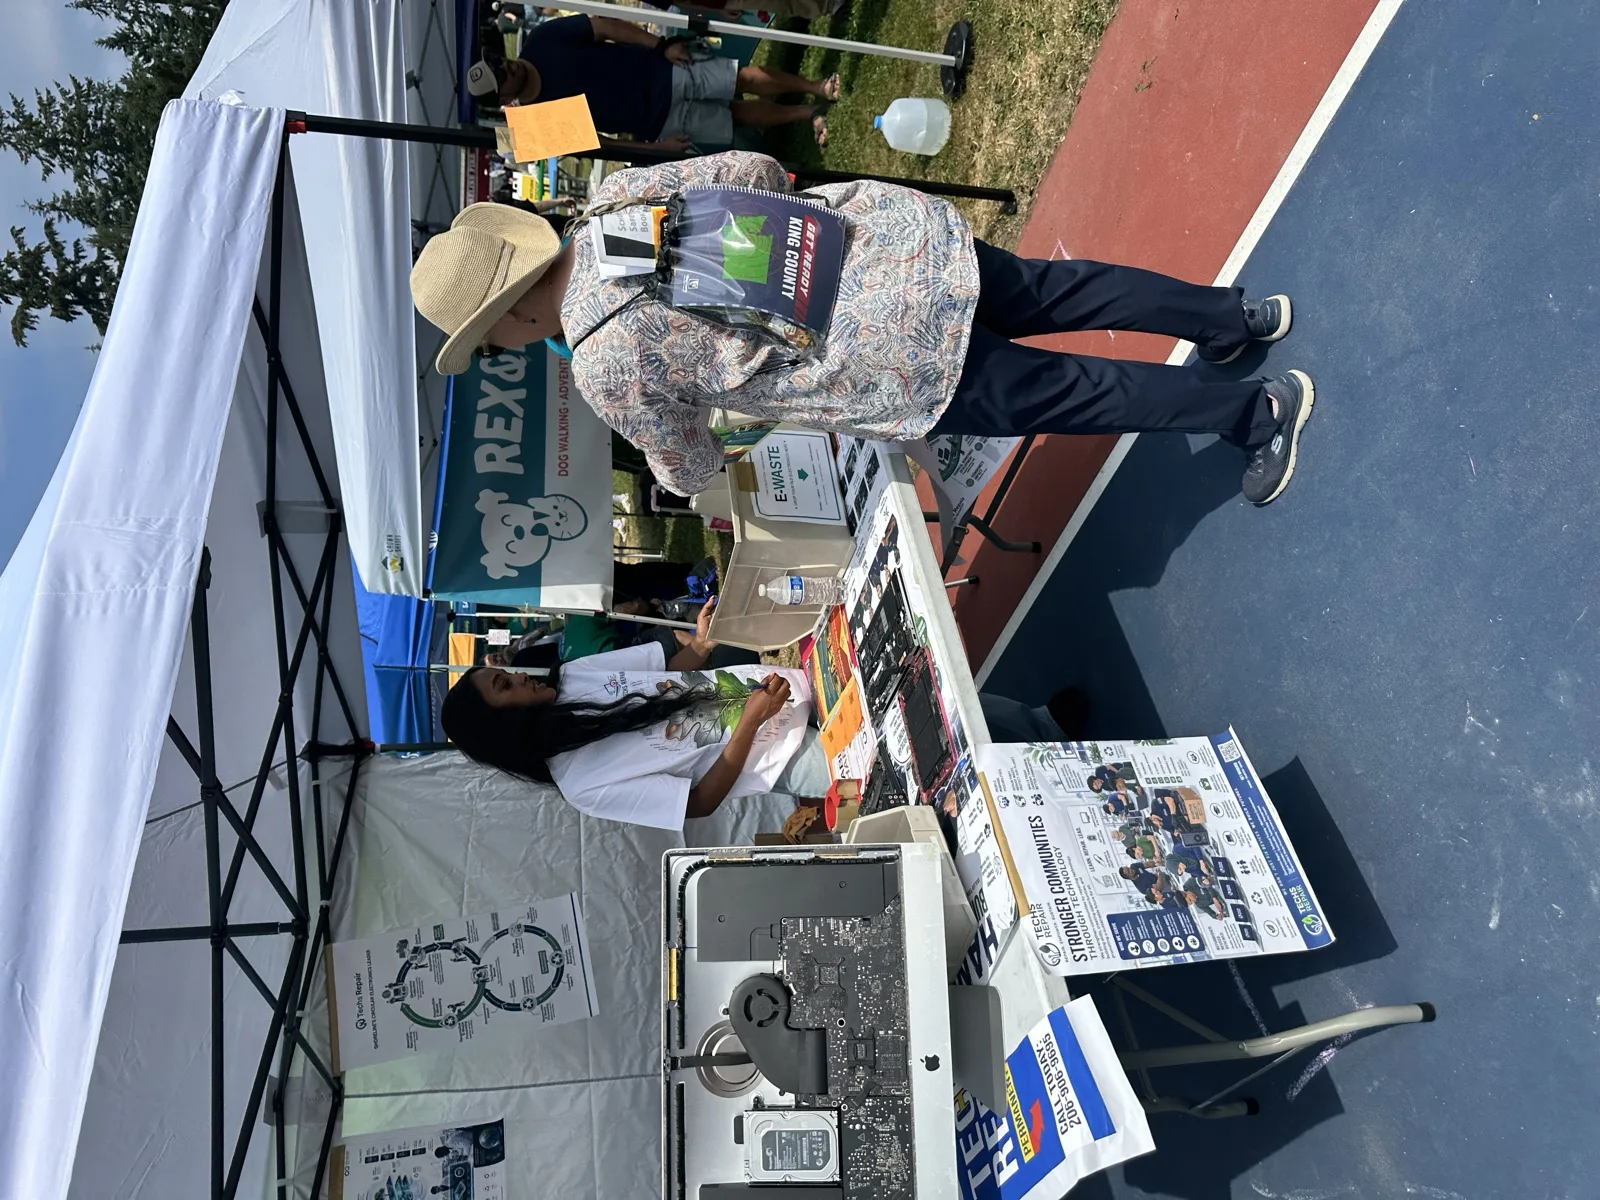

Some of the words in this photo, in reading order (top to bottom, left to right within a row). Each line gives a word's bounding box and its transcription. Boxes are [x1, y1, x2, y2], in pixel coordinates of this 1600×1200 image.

[786, 216, 803, 249] KING
[805, 221, 816, 250] GET
[781, 249, 799, 301] COUNTY
[800, 250, 813, 298] READY
[558, 357, 569, 400] ADVENT
[474, 346, 526, 475] REX&
[558, 407, 569, 452] WALKING
[558, 454, 569, 477] DOG
[767, 445, 788, 503] E-WASTE
[1028, 815, 1065, 894] COMMUNITIES
[1052, 845, 1081, 908] TECHNOLOGY
[1289, 886, 1306, 914] TECHS
[1295, 884, 1313, 911] REPAIR
[1030, 903, 1044, 940] TECHS
[1035, 902, 1053, 938] REPAIR
[1053, 897, 1088, 962] STRONGER
[1075, 909, 1098, 961] THROUGH
[354, 972, 363, 995] Repair
[356, 996, 364, 1018] Techs
[369, 997, 377, 1019] CIRCULAR
[1035, 1039, 1056, 1096] TODAY:
[1042, 1033, 1082, 1129] 206-906-9695
[1053, 1094, 1069, 1136] CALL
[975, 1097, 1019, 1188] RE
